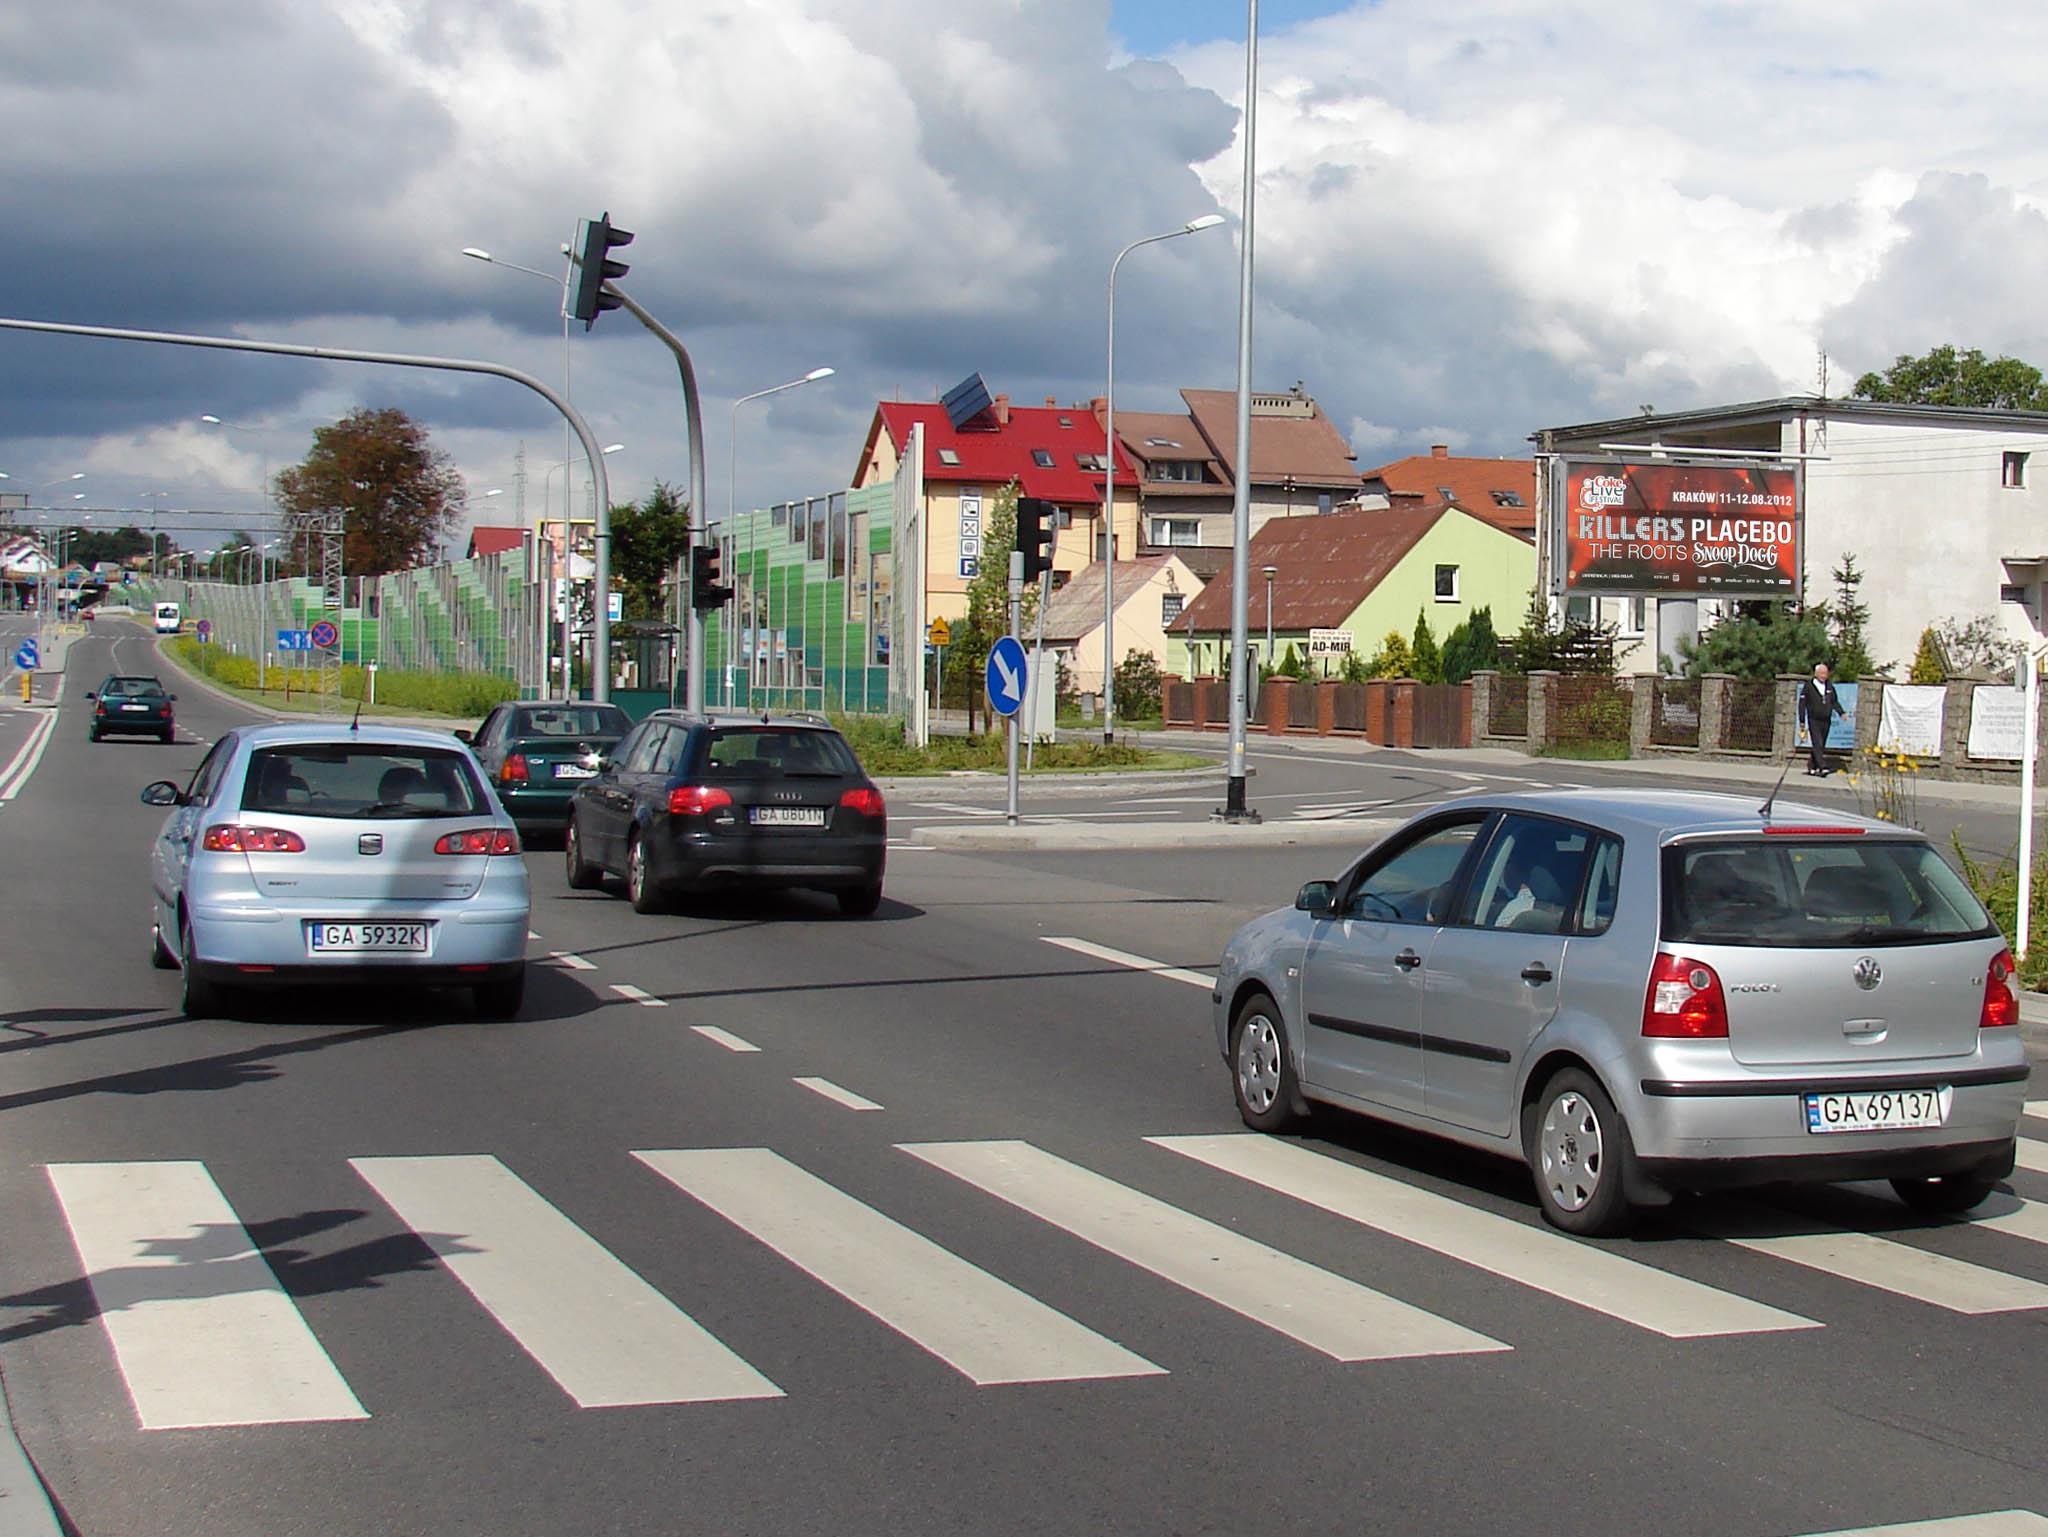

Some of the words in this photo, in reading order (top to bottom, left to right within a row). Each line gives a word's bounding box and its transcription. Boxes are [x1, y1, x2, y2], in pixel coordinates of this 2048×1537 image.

[1595, 477, 1622, 487] Coke
[1590, 495, 1622, 503] FESTIVAL
[1672, 489, 1716, 503] KRAKÓW
[1719, 492, 1792, 506] 11-12.08.2012
[1691, 518, 1792, 544] PLACEBO
[1588, 543, 1623, 559] THE
[1627, 543, 1688, 561] ROOTS
[1691, 542, 1737, 564] SNOOP
[1736, 543, 1778, 566] DOGG
[1312, 641, 1351, 652] AD-MIR
[759, 807, 778, 821] GA
[327, 926, 354, 944] GA
[362, 926, 421, 945] 5932K
[1731, 984, 1770, 992] POLO
[1824, 1096, 1858, 1123] GA
[1867, 1093, 1933, 1121] 69137
